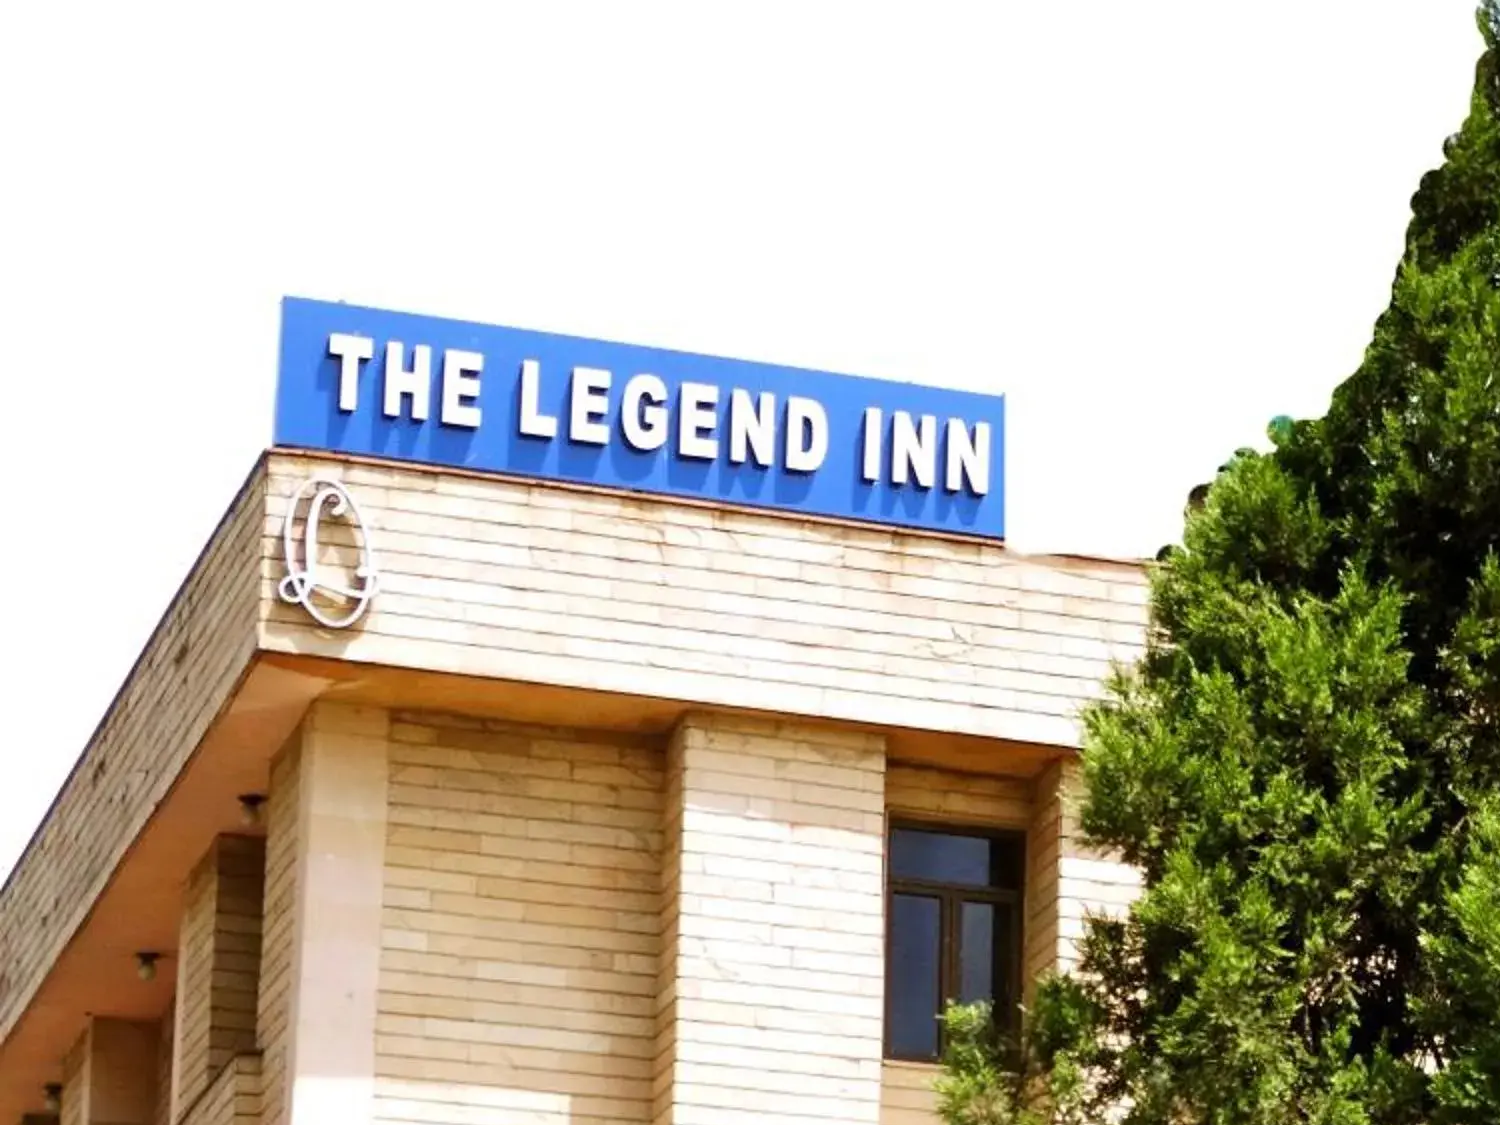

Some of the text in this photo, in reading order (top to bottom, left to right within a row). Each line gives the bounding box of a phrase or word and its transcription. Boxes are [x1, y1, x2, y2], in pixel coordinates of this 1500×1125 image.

[328, 332, 991, 496] THE LEGEND INN
